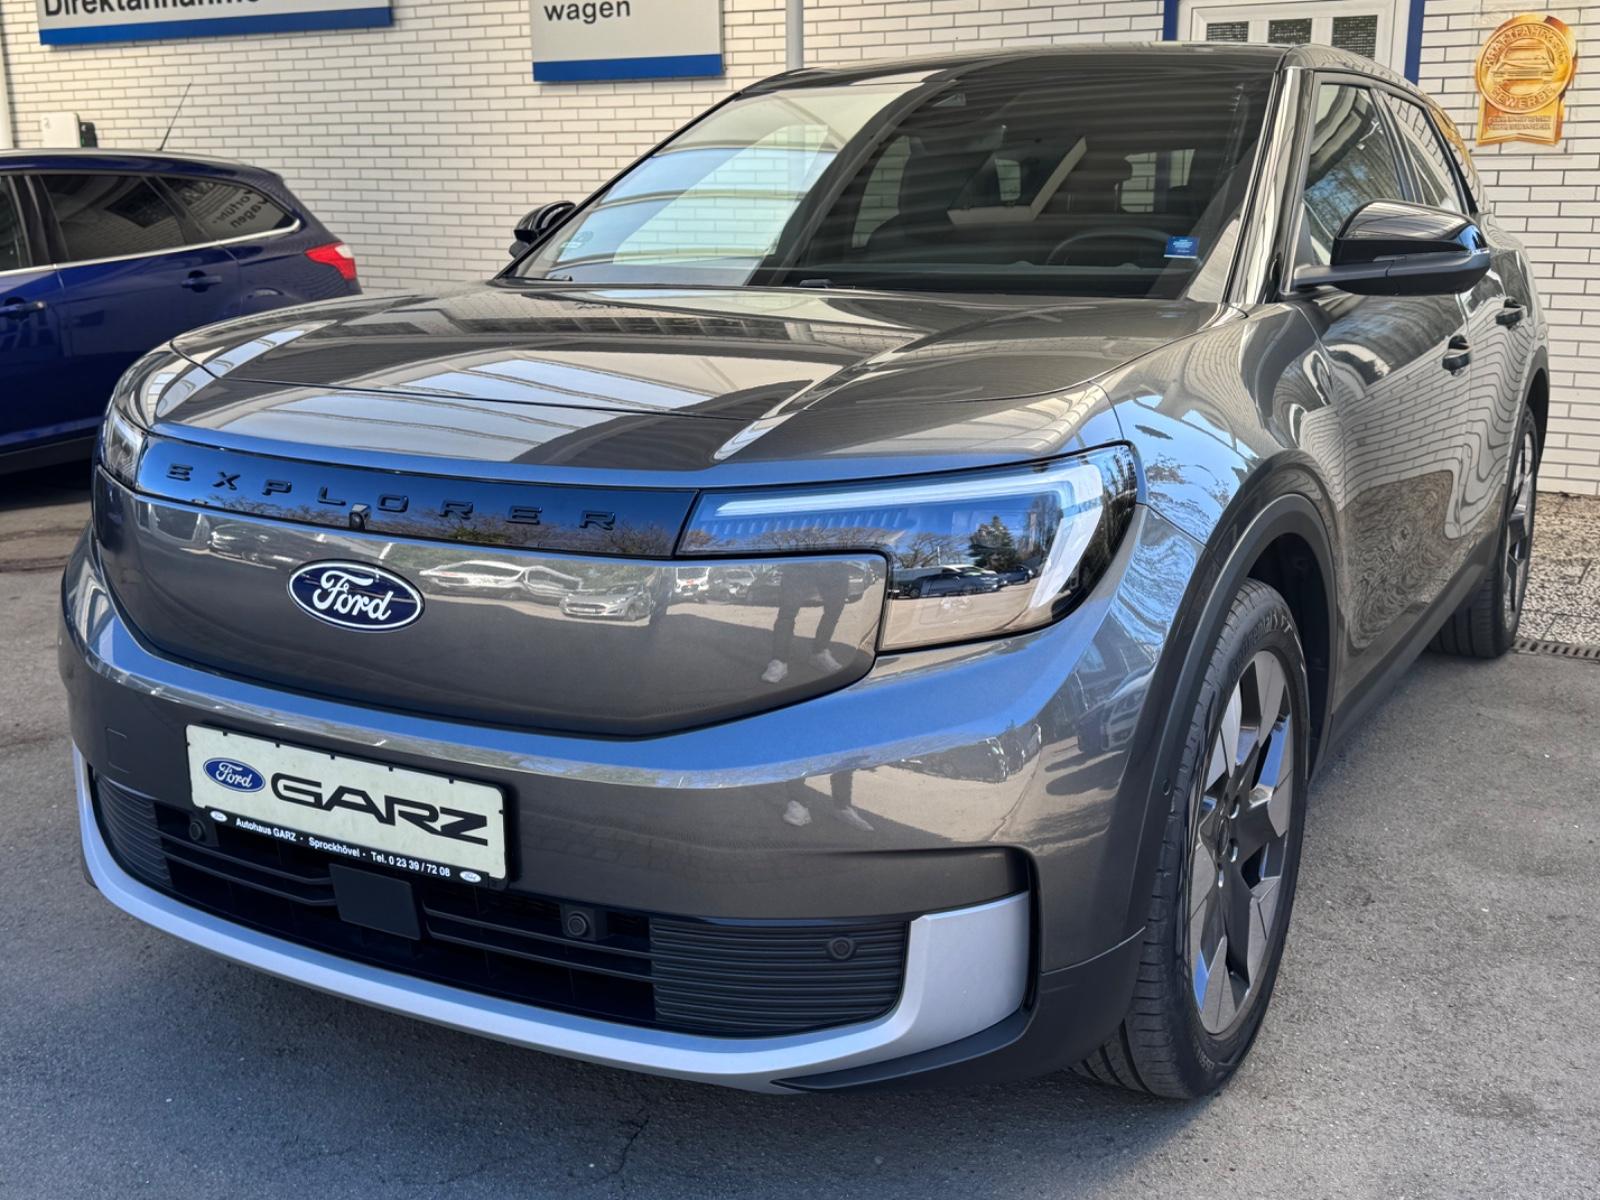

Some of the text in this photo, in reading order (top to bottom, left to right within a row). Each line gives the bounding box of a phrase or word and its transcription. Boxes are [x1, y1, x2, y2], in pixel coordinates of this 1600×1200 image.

[44, 0, 259, 16] Direkta
[544, 1, 630, 24] wagen
[166, 464, 616, 530] EXPLORER
[313, 569, 393, 621] Ford
[216, 761, 488, 846] Ford GARZ
[236, 818, 272, 835] Autohaus
[273, 828, 296, 841] GARZ
[308, 837, 360, 857] Sprockhövel
[371, 851, 387, 864] Tel.
[388, 856, 394, 865] 0
[396, 857, 407, 868] 23
[408, 860, 420, 870] 39
[426, 863, 438, 874] 72
[439, 866, 451, 877] 08
